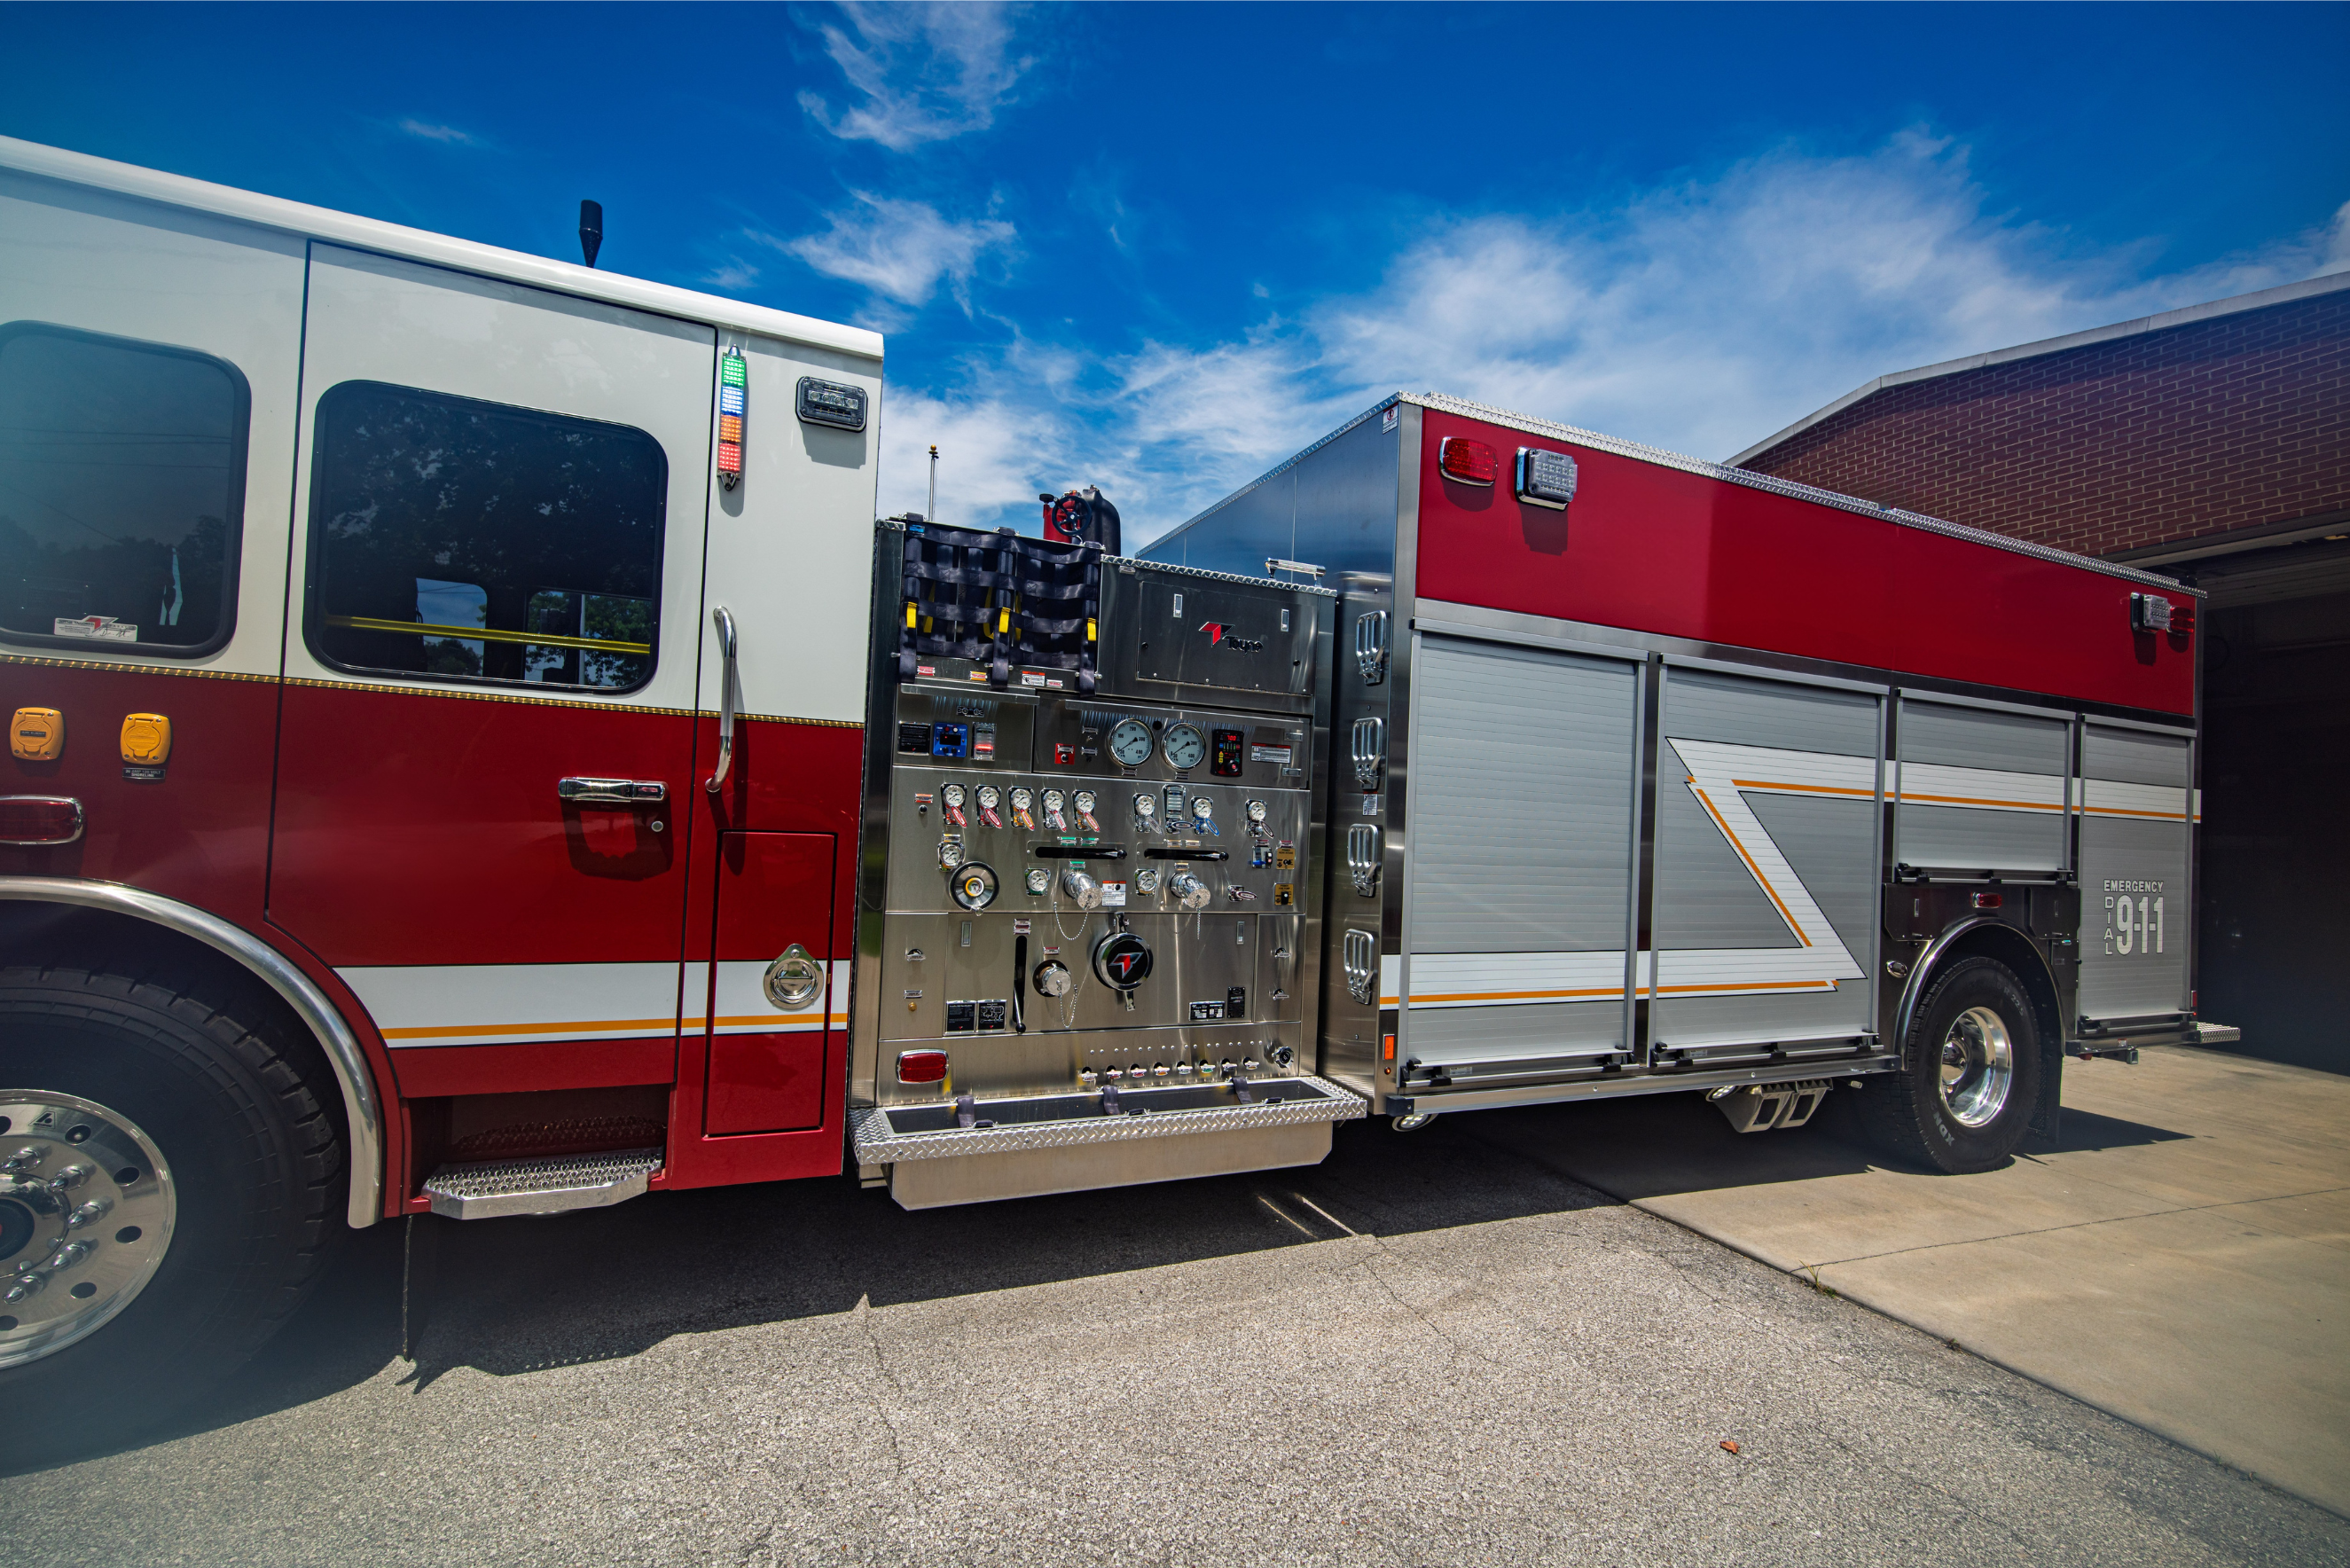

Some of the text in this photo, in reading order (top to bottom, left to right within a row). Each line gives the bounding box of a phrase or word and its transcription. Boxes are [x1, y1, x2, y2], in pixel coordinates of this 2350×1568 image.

[1222, 635, 1263, 655] Toyne
[2103, 879, 2164, 893] EMERGENCY
[2103, 896, 2114, 955] DIAL
[2116, 895, 2164, 955] 9-1-1
